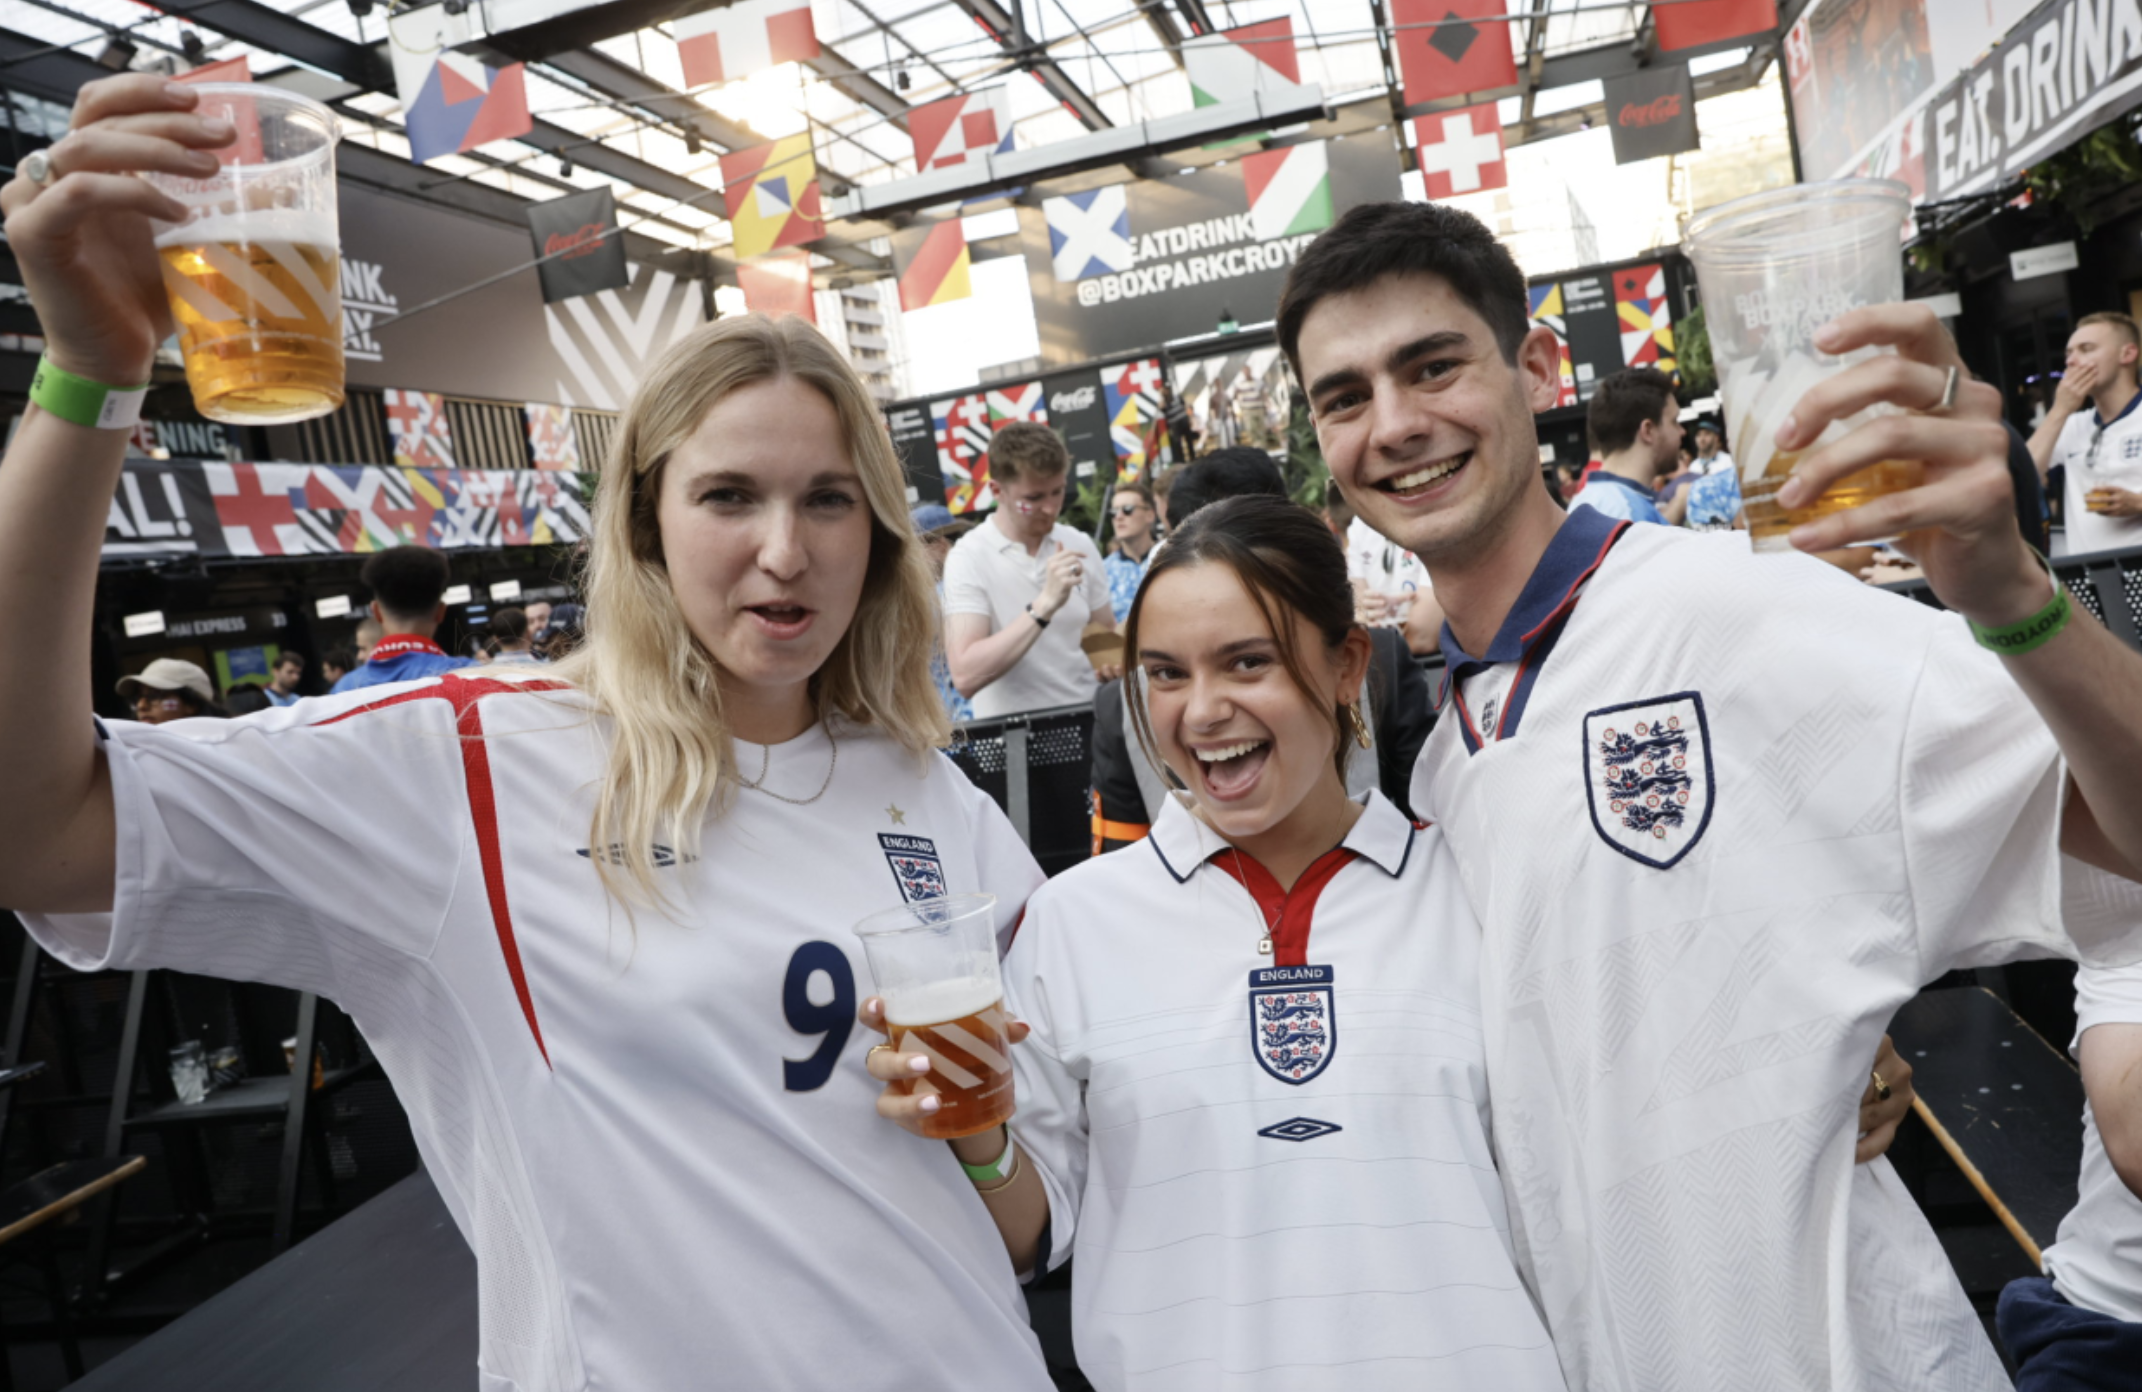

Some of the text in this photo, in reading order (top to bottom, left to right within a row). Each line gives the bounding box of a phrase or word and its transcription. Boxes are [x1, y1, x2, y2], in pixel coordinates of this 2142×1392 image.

[1618, 94, 1682, 127] Coca-Cola
[1936, 69, 1999, 193] EAT.
[1050, 386, 1096, 413] Coca-Cola
[194, 616, 247, 635] EXPRESS
[883, 836, 934, 853] ENGLAND
[1260, 968, 1324, 981] ENGLAND
[783, 940, 856, 1092] 9
